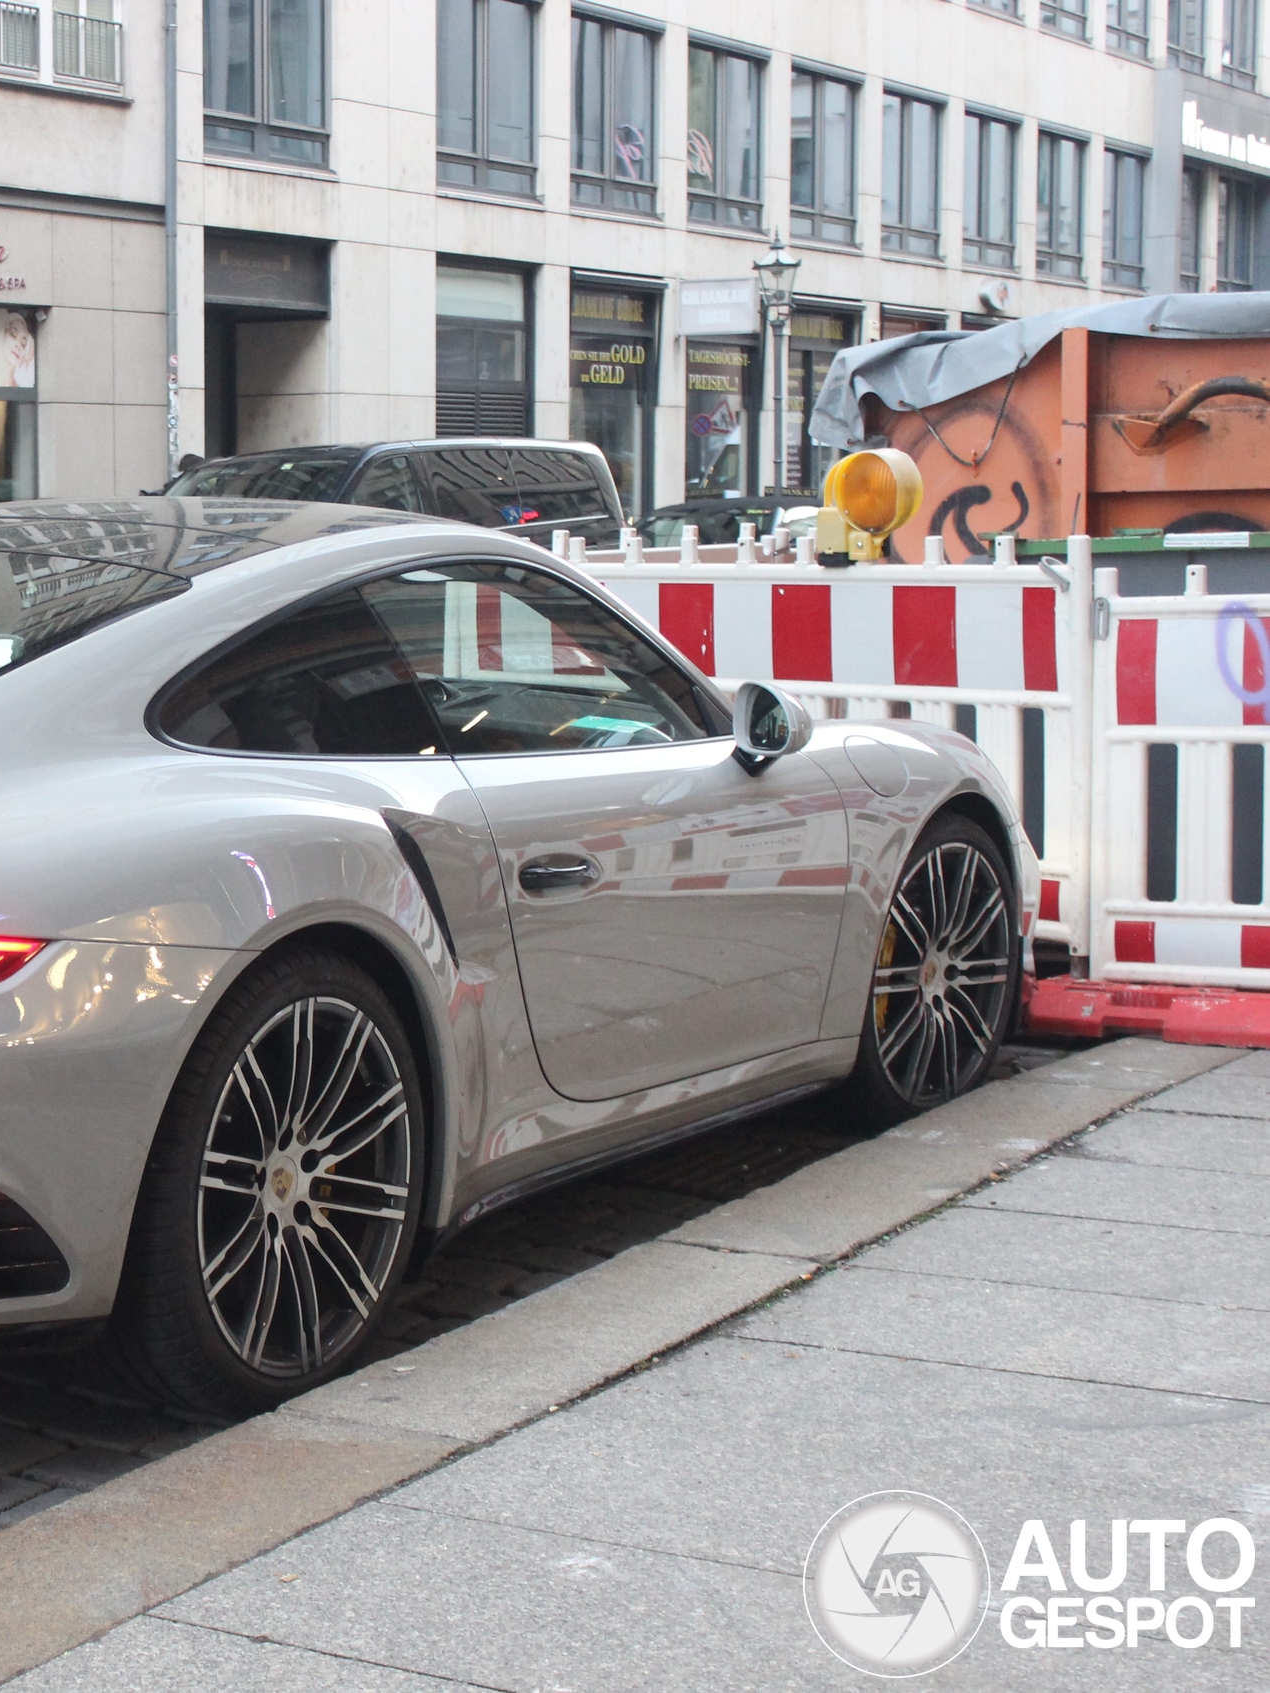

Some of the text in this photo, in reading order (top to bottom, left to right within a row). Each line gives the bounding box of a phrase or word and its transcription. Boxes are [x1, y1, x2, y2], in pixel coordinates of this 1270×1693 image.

[7, 278, 27, 290] SPA
[610, 343, 645, 365] GOLD
[590, 364, 625, 385] GELD
